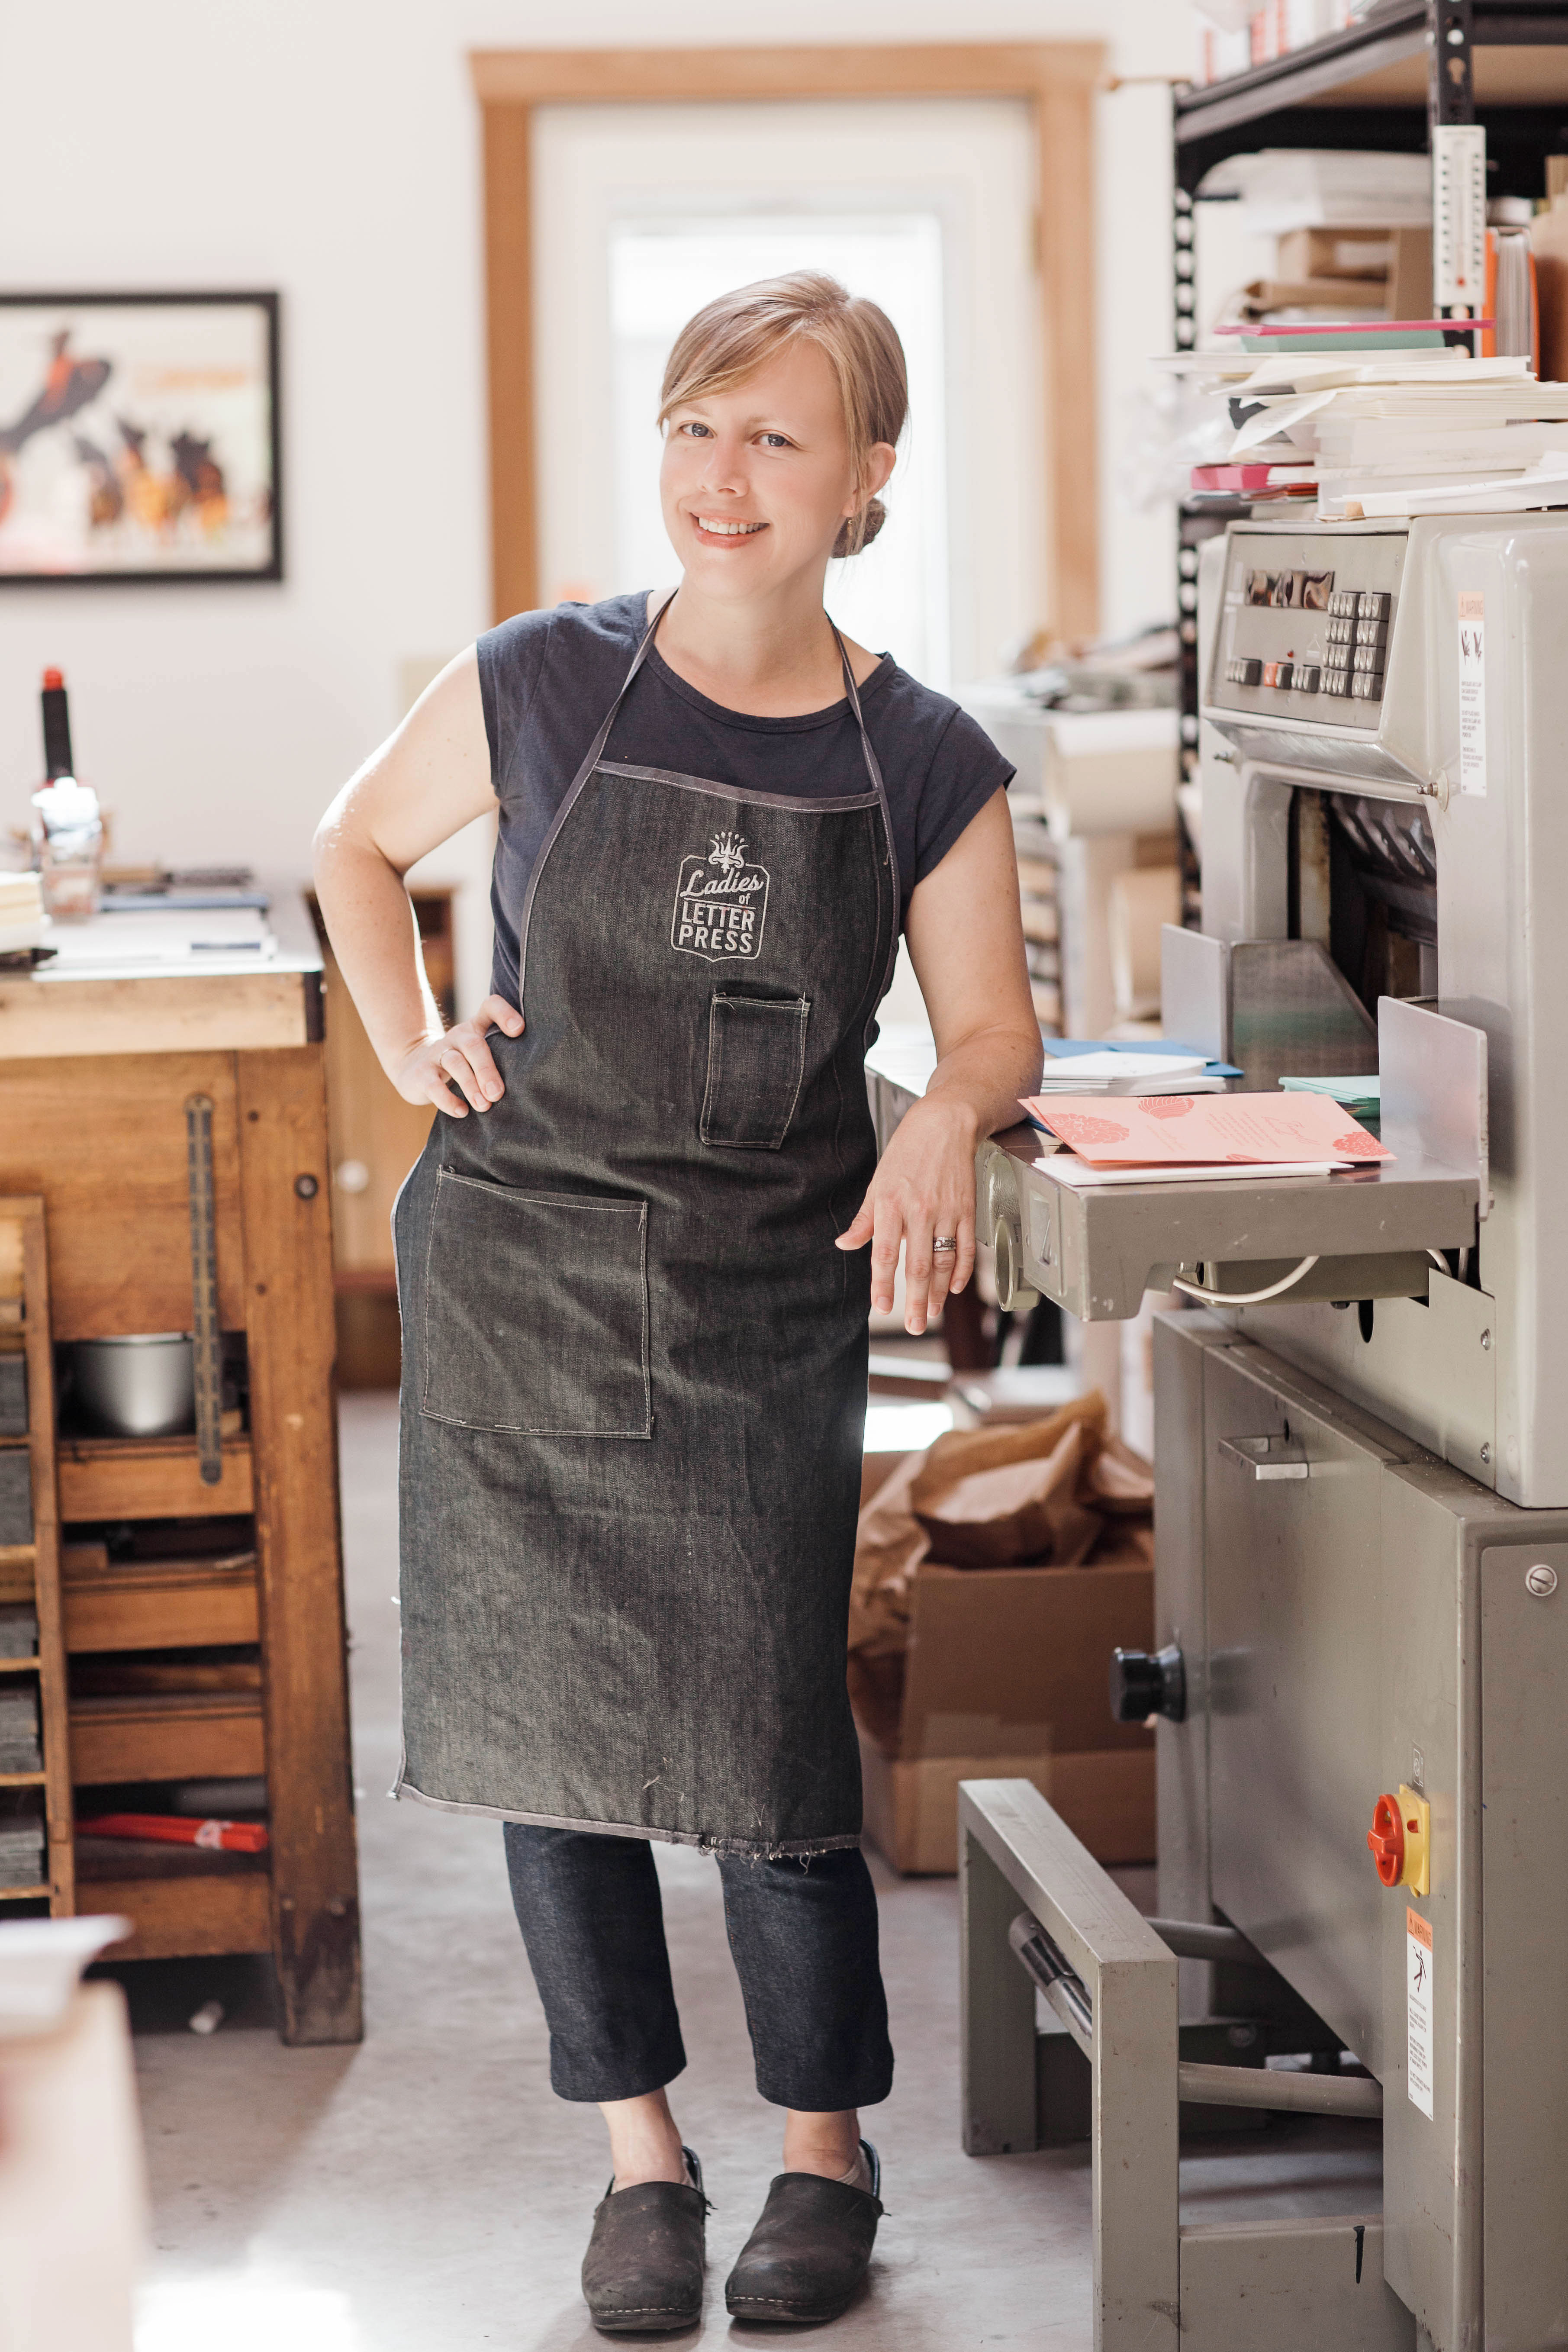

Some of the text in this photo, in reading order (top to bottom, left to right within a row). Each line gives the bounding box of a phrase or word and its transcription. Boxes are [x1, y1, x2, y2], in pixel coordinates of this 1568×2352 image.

[679, 867, 764, 897] Ladies
[738, 893, 751, 905] of
[682, 901, 755, 931] LETTER
[678, 924, 753, 954] PRESS
